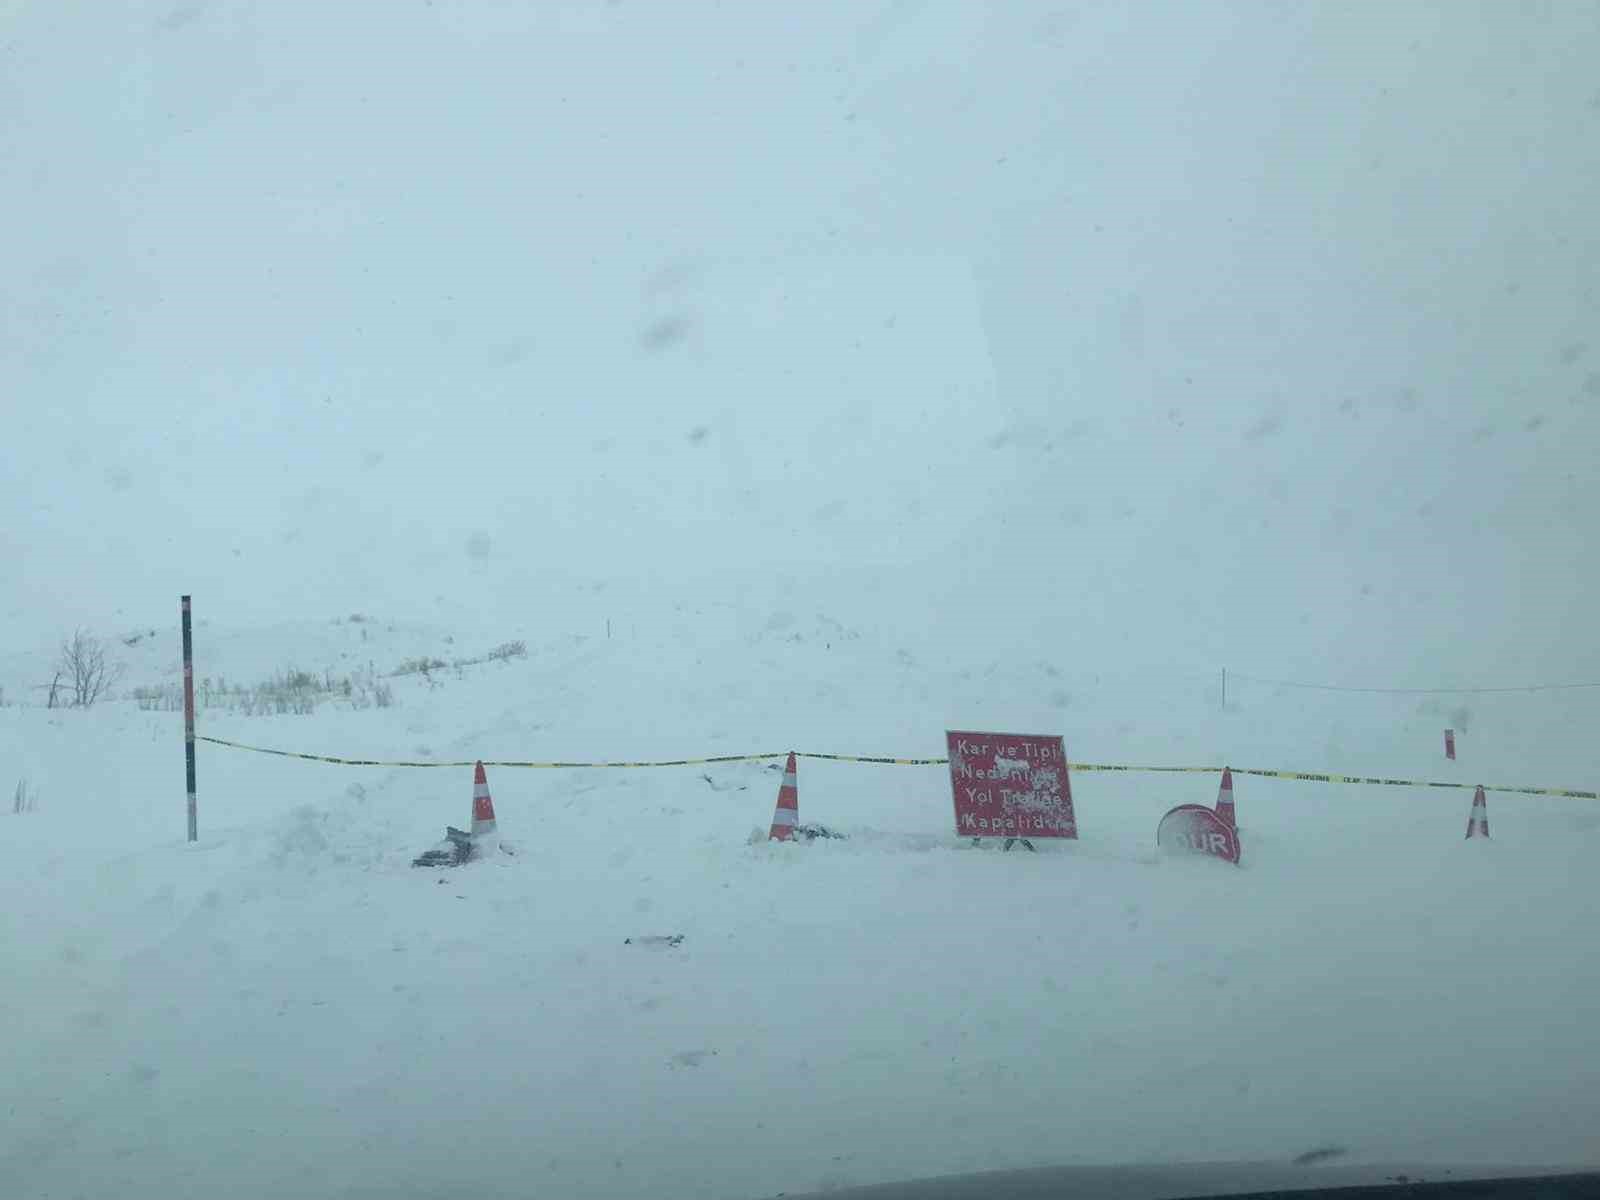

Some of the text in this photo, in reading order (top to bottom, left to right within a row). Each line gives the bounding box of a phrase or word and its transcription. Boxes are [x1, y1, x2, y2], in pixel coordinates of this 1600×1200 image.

[957, 739, 989, 756] Kar
[996, 743, 1018, 757] ve
[1022, 743, 1057, 761] Tipi
[961, 763, 1057, 785] Nednie
[965, 787, 993, 804] Yol
